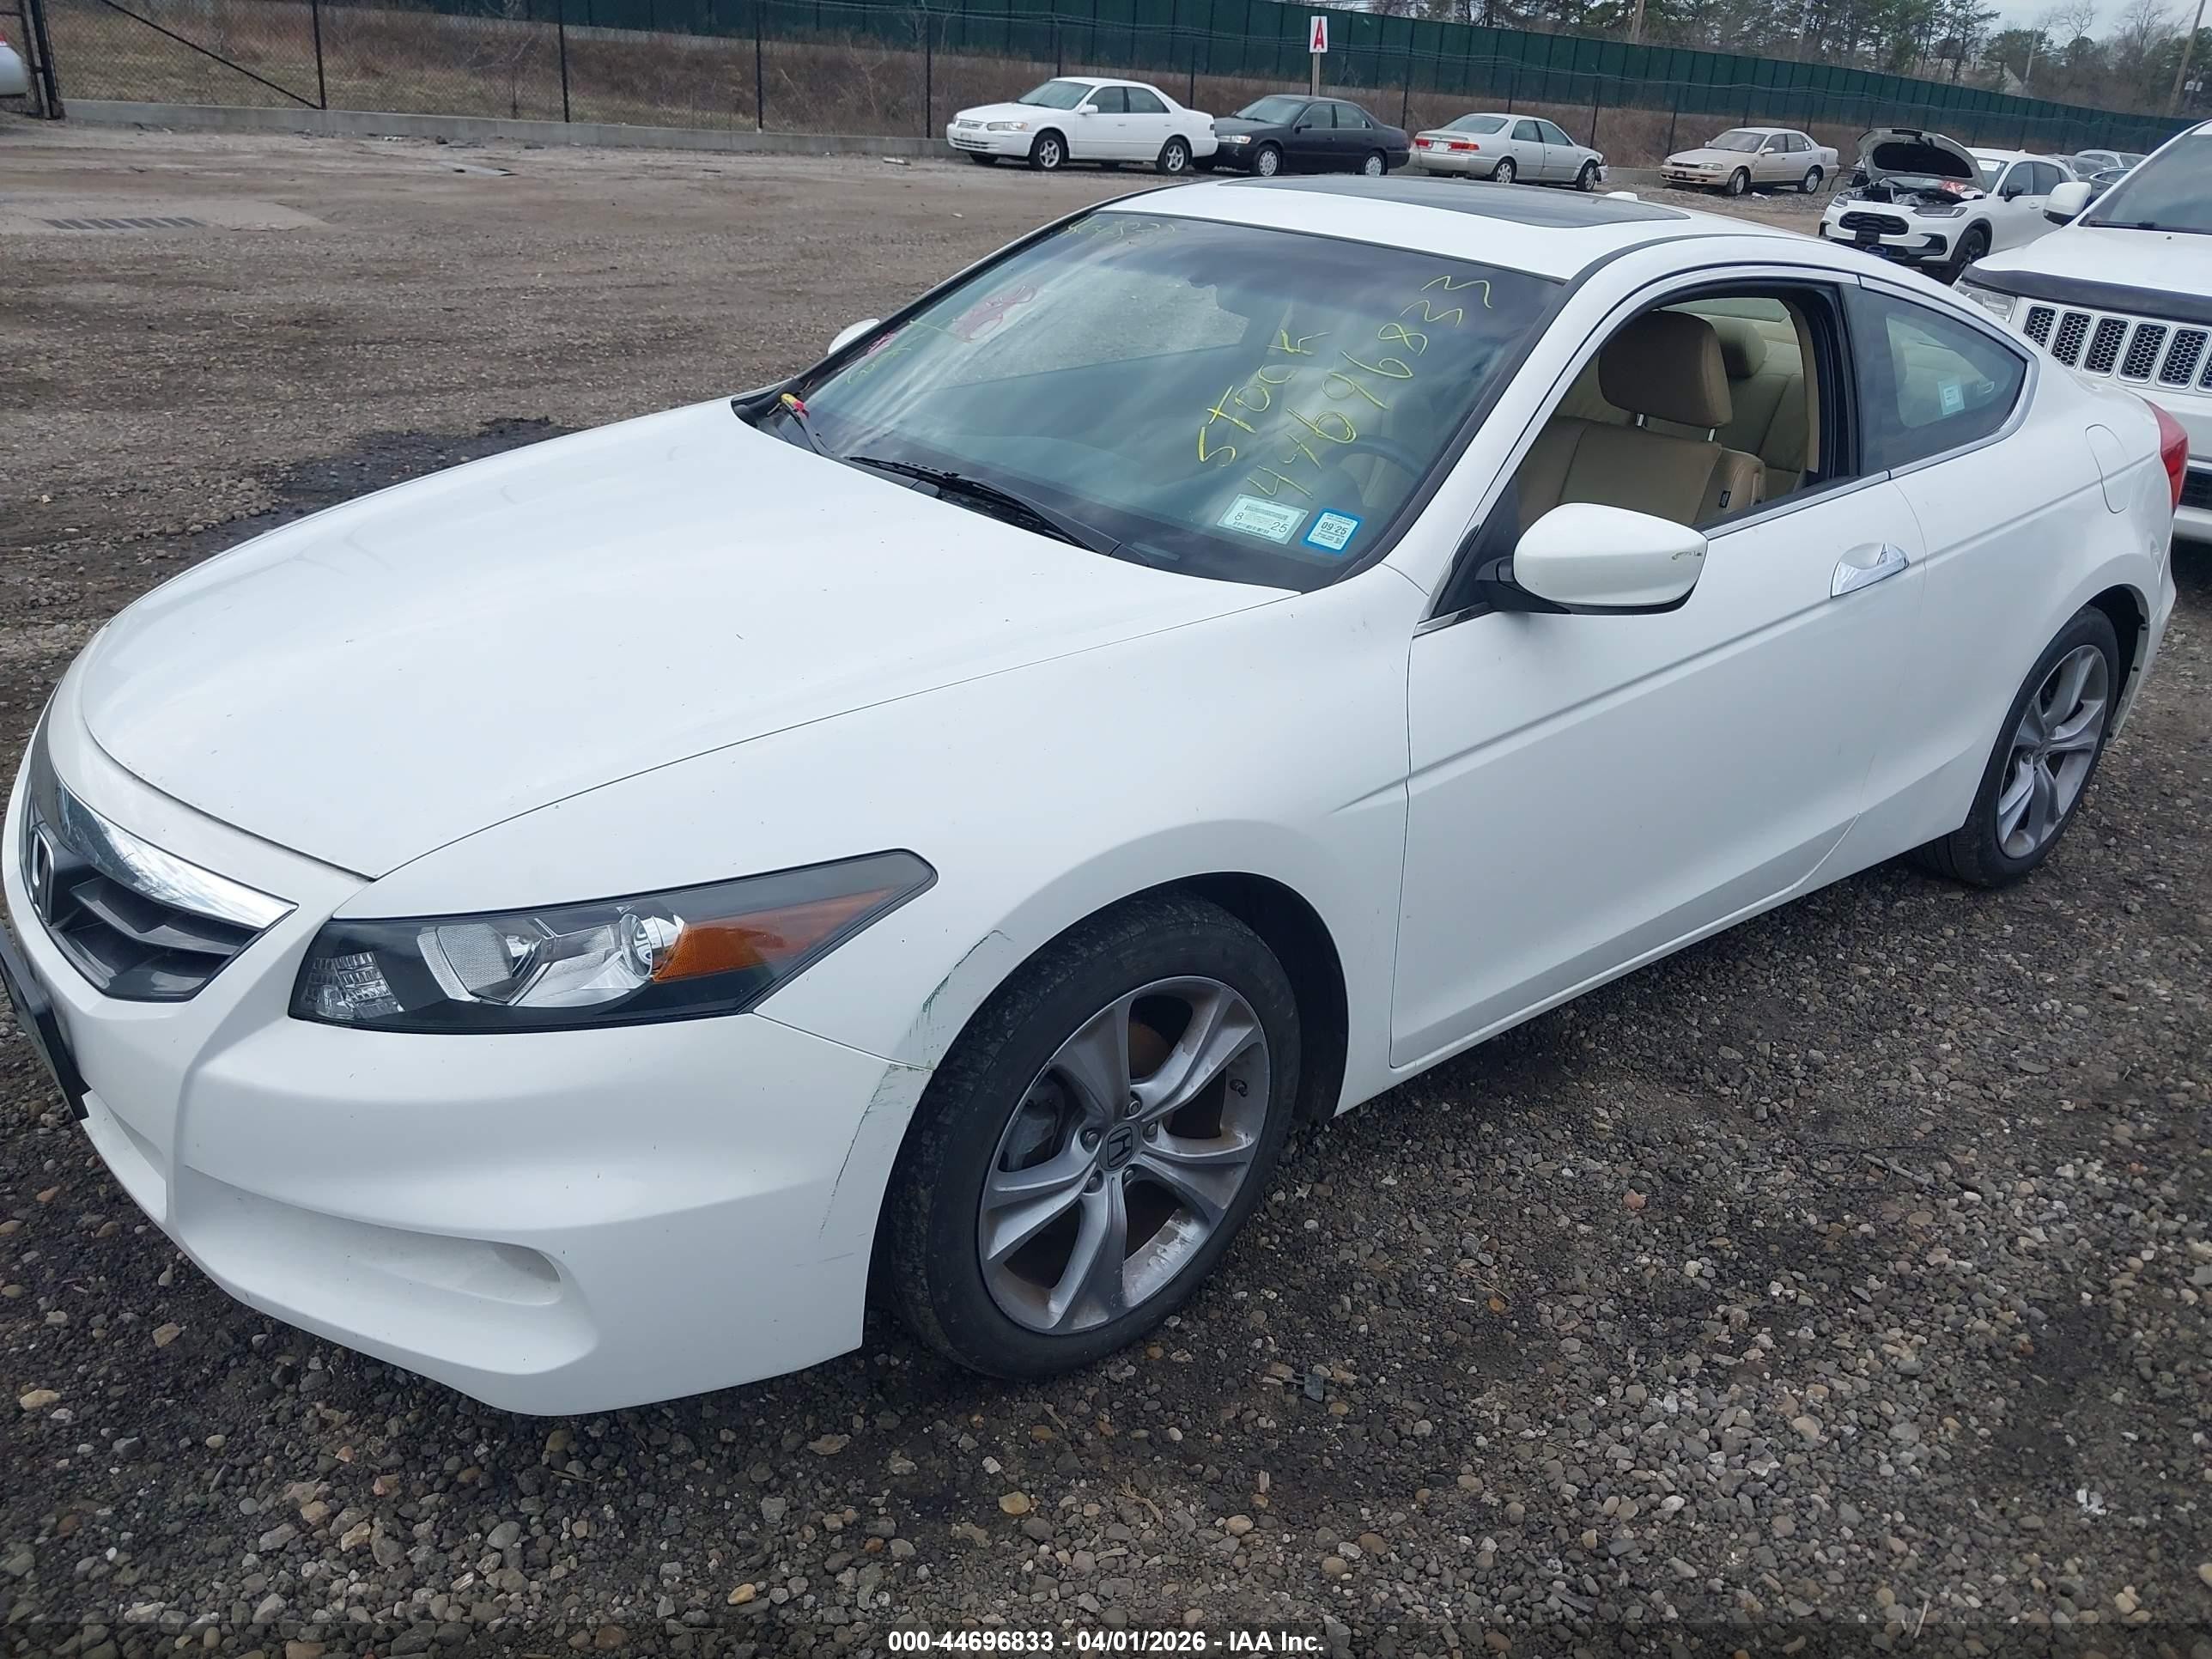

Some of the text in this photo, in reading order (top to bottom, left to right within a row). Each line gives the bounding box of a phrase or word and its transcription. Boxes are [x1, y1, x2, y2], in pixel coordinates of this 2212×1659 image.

[1313, 17, 1325, 49] A
[1246, 275, 1493, 500] 44696833
[1234, 512, 1244, 521] 8
[1270, 521, 1289, 533] 25
